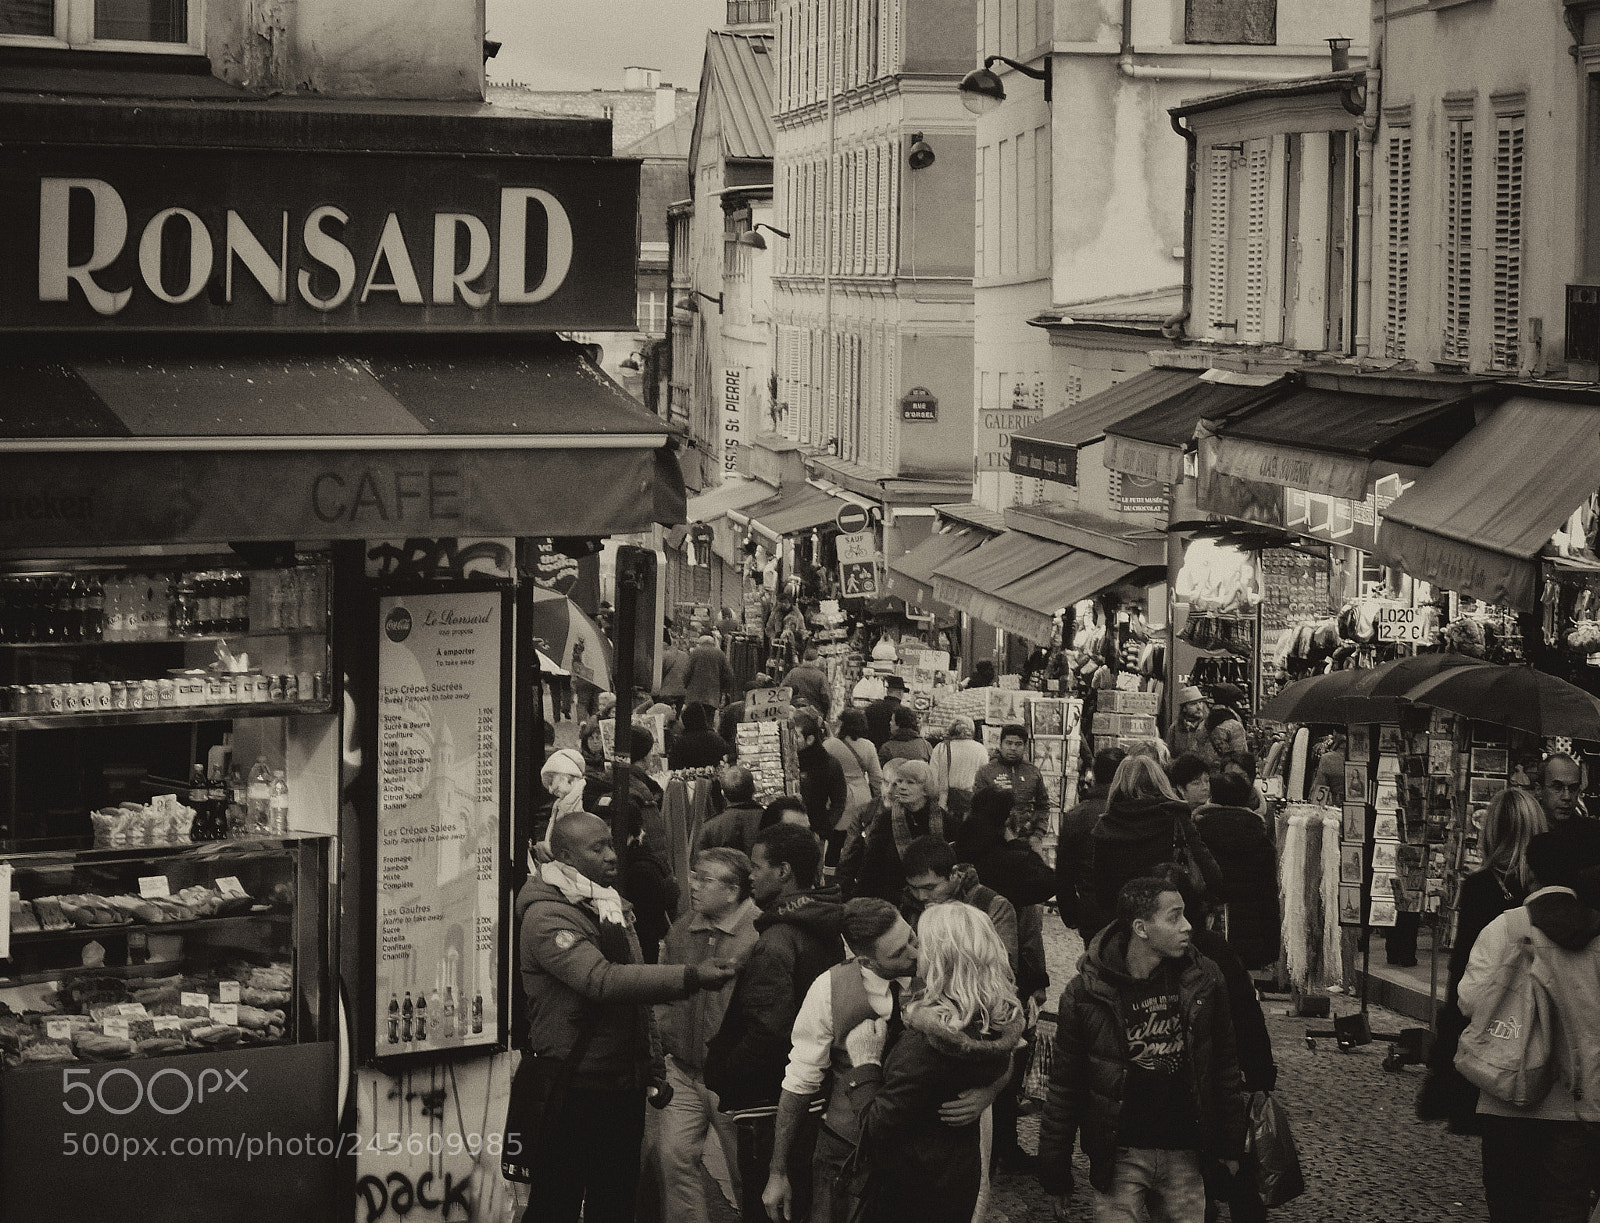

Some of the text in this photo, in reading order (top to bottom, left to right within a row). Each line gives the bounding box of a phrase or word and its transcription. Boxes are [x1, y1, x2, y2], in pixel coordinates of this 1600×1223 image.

[38, 176, 574, 316] RONSARD
[725, 369, 740, 413] PIERRE
[912, 402, 926, 410] RUE
[984, 412, 1041, 430] GALERIES
[998, 433, 1011, 448] D
[310, 471, 459, 521] CAFE
[845, 535, 864, 543] SAUF
[439, 605, 493, 626] Ronsard
[444, 648, 475, 657] emporter
[384, 686, 399, 695] Les
[384, 732, 413, 740] Confiture
[383, 828, 397, 837] Les
[383, 905, 431, 916] Les Gaufres
